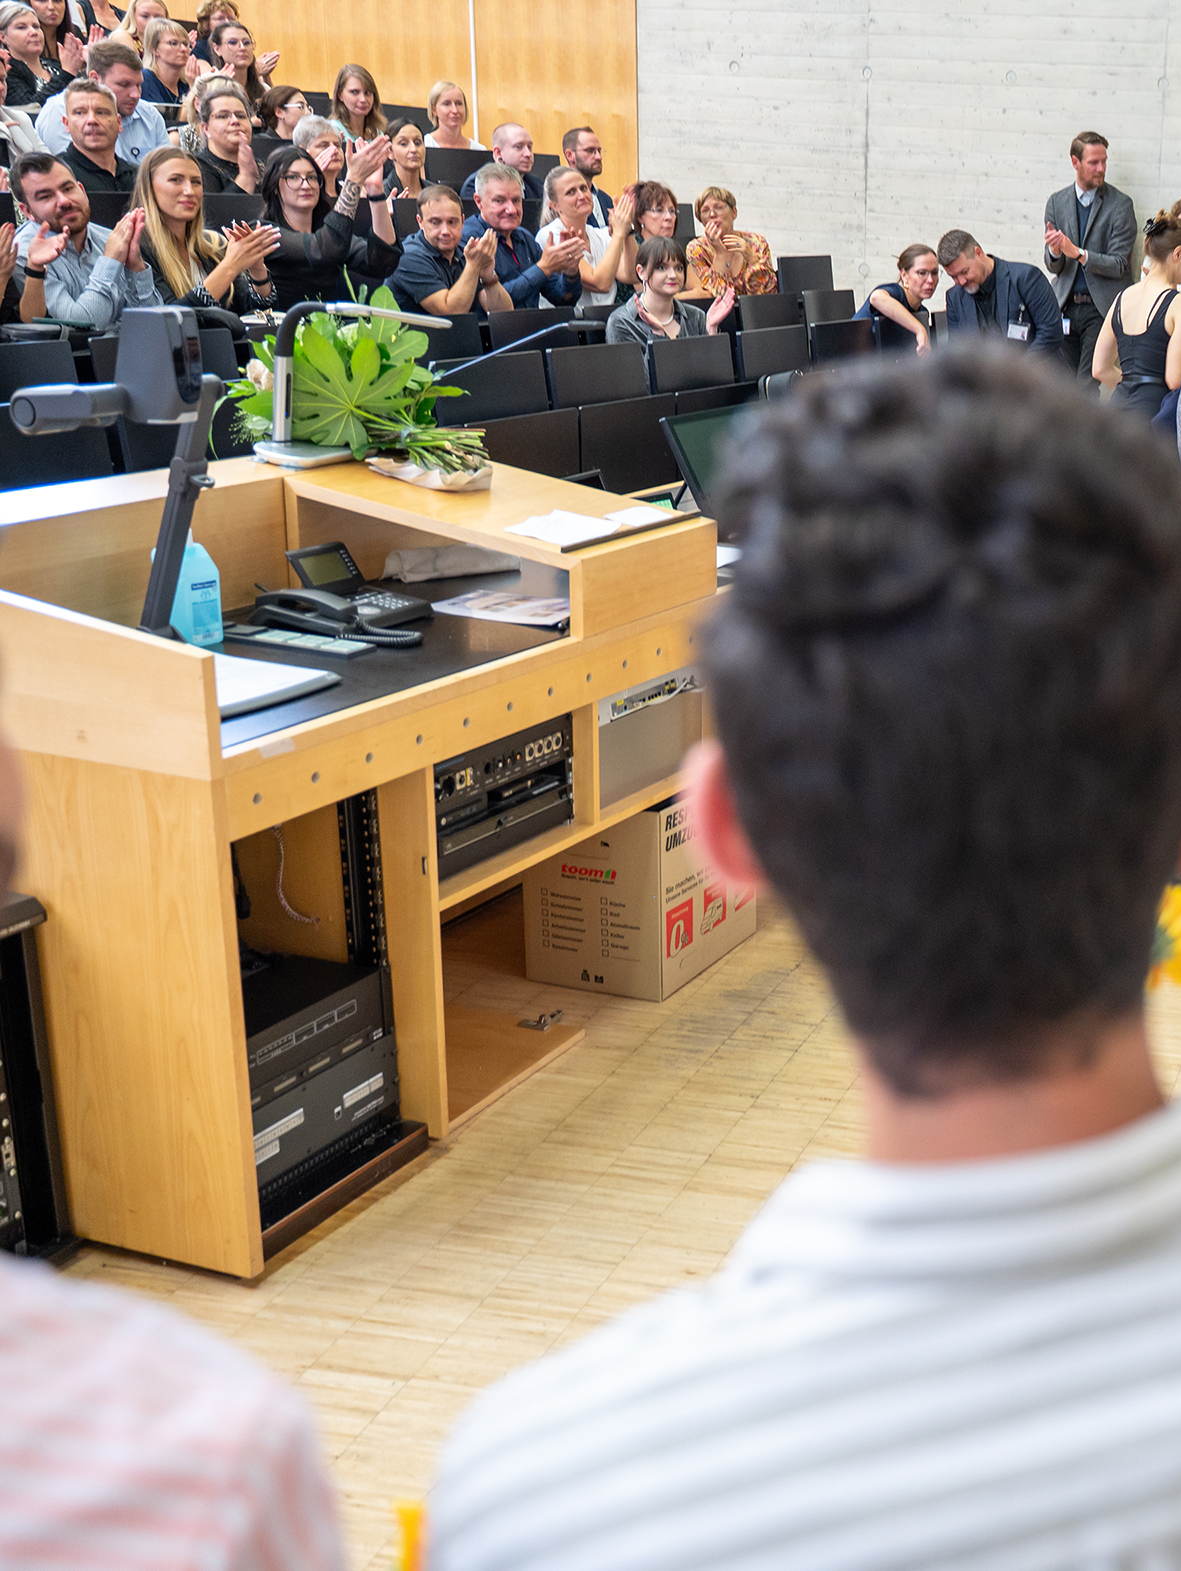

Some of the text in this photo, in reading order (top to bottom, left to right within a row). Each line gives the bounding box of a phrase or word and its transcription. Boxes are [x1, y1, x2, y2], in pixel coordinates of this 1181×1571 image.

[665, 804, 693, 832] RESP
[665, 823, 698, 852] UMZU
[561, 863, 604, 878] toom
[665, 884, 674, 895] Sie
[610, 942, 629, 950] Garage
